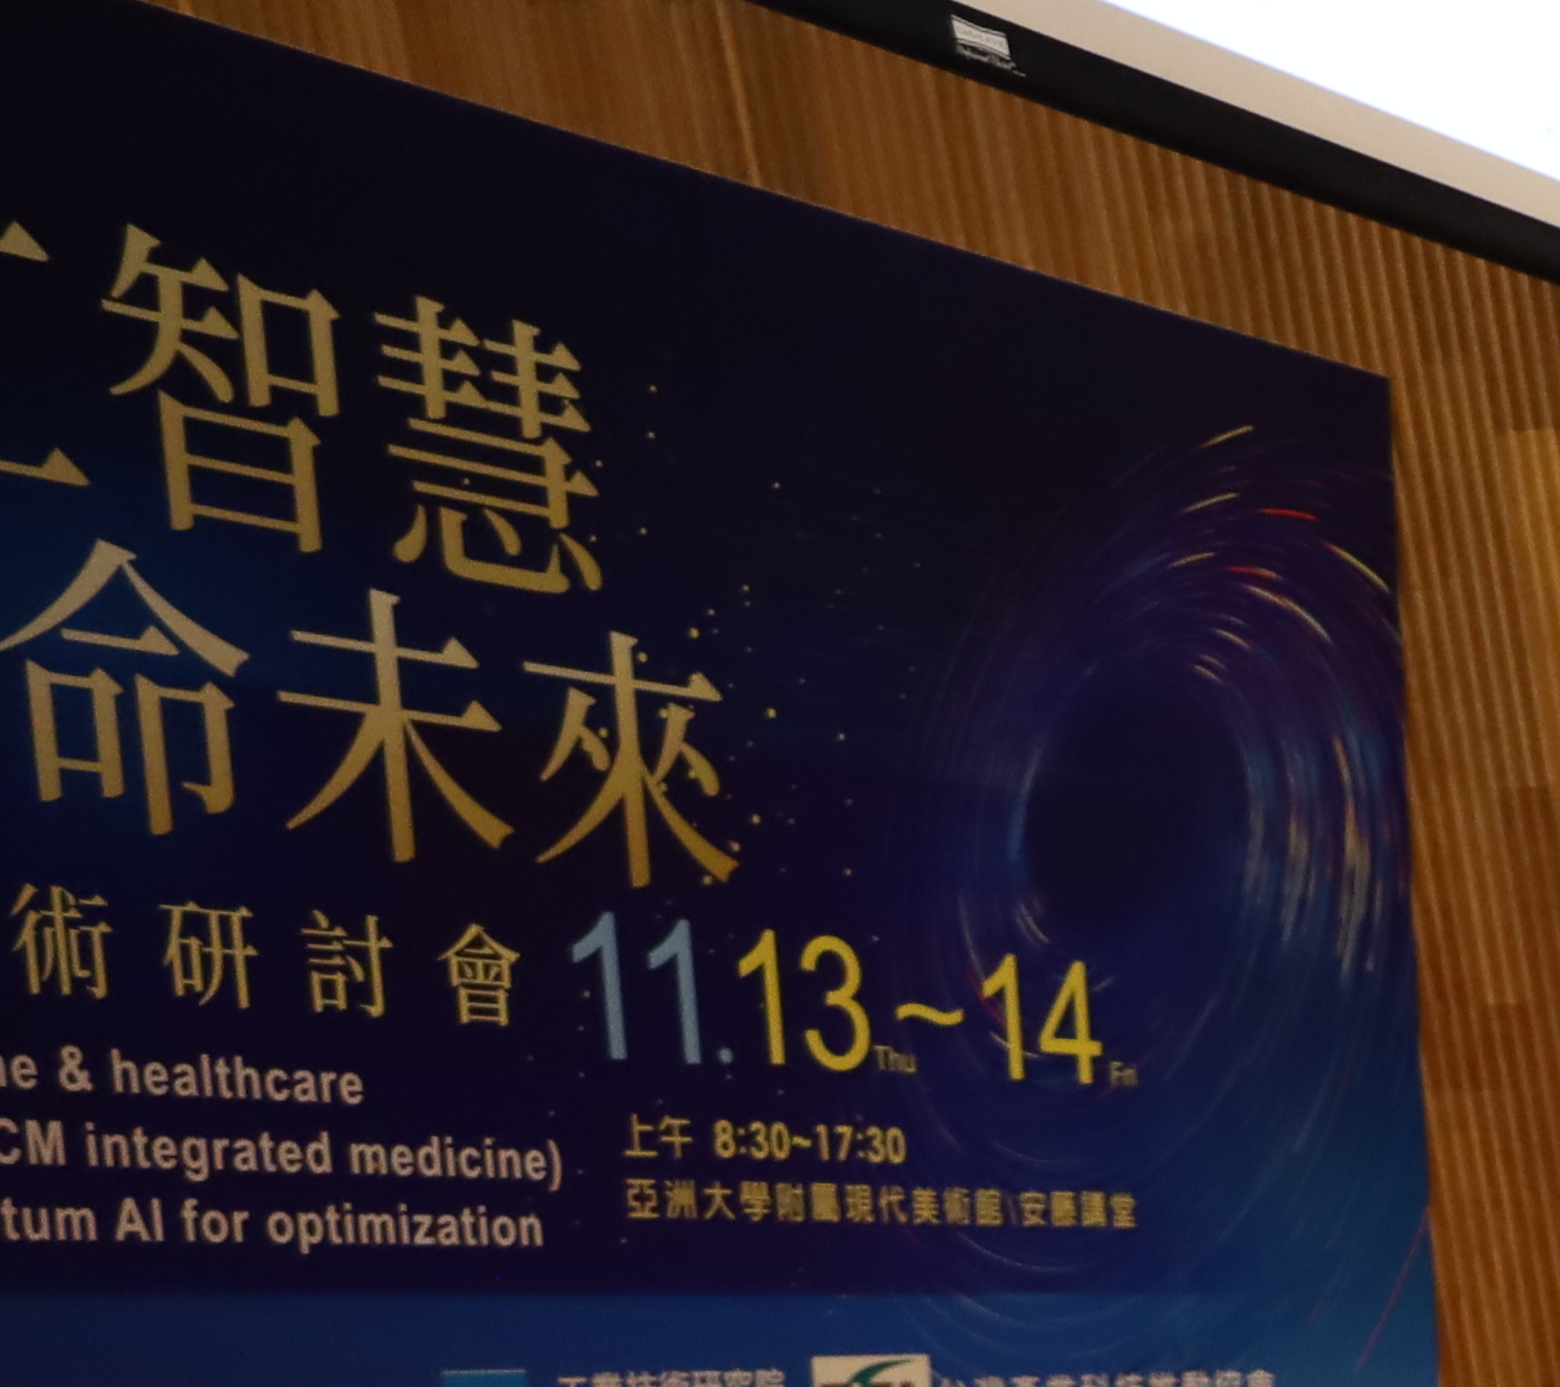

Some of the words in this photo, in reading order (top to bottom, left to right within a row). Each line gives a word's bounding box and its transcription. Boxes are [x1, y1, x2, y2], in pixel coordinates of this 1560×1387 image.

[0, 538, 740, 888] 命未來
[11, 884, 521, 1026] 術研討會
[59, 1045, 93, 1092] &
[111, 1048, 364, 1104] healthcare
[84, 1121, 332, 1181] integrated
[349, 1137, 562, 1191] medicine)
[624, 1114, 692, 1157] 上午
[714, 1119, 907, 1164] 8:30~17:30
[1, 1197, 98, 1241] tum
[115, 1197, 165, 1242] AI
[180, 1197, 249, 1243] for
[267, 1202, 544, 1254] optimization
